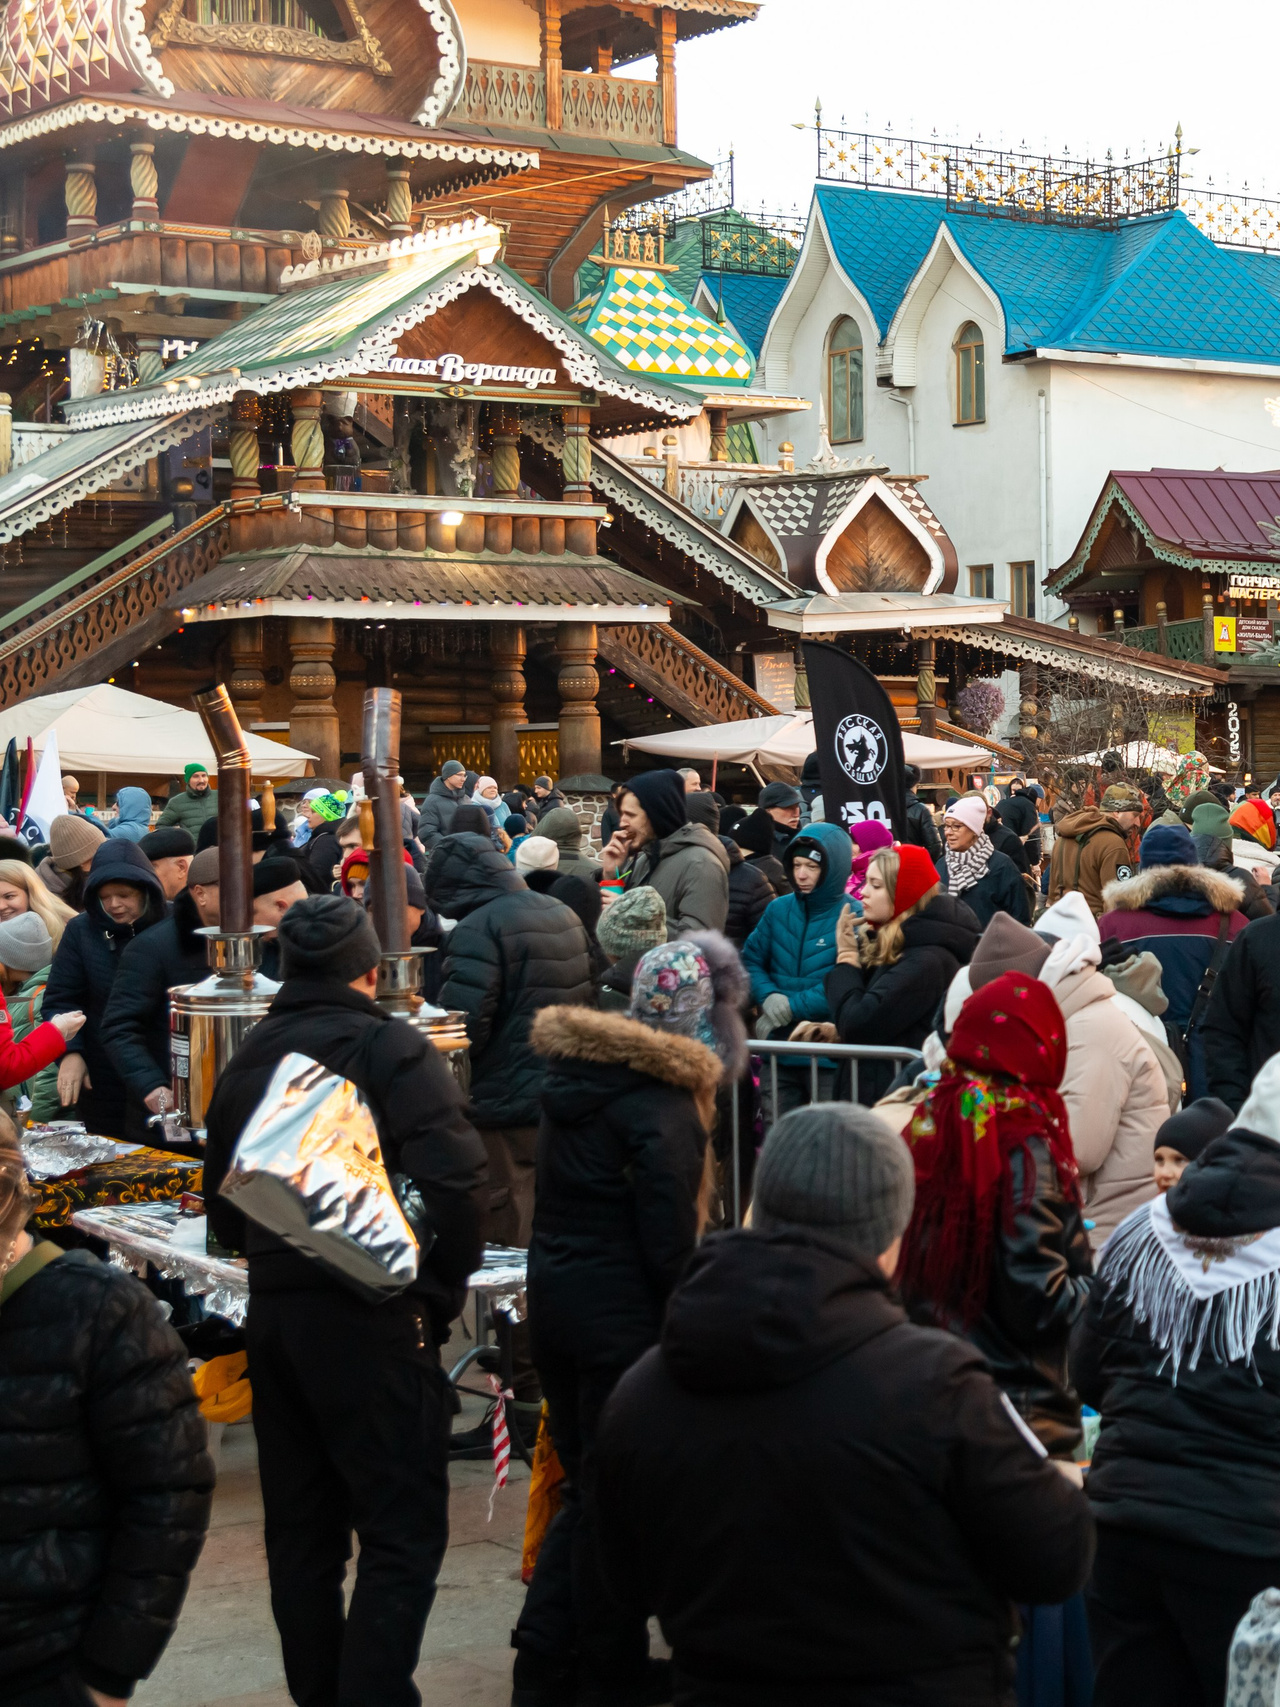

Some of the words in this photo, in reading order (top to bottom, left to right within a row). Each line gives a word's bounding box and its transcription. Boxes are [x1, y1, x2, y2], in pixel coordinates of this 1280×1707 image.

[387, 357, 438, 377] лая
[437, 353, 557, 390] Веранда
[837, 716, 883, 741] РУССКАЯ
[1227, 702, 1241, 762] 2025
[344, 1163, 384, 1195] adida
